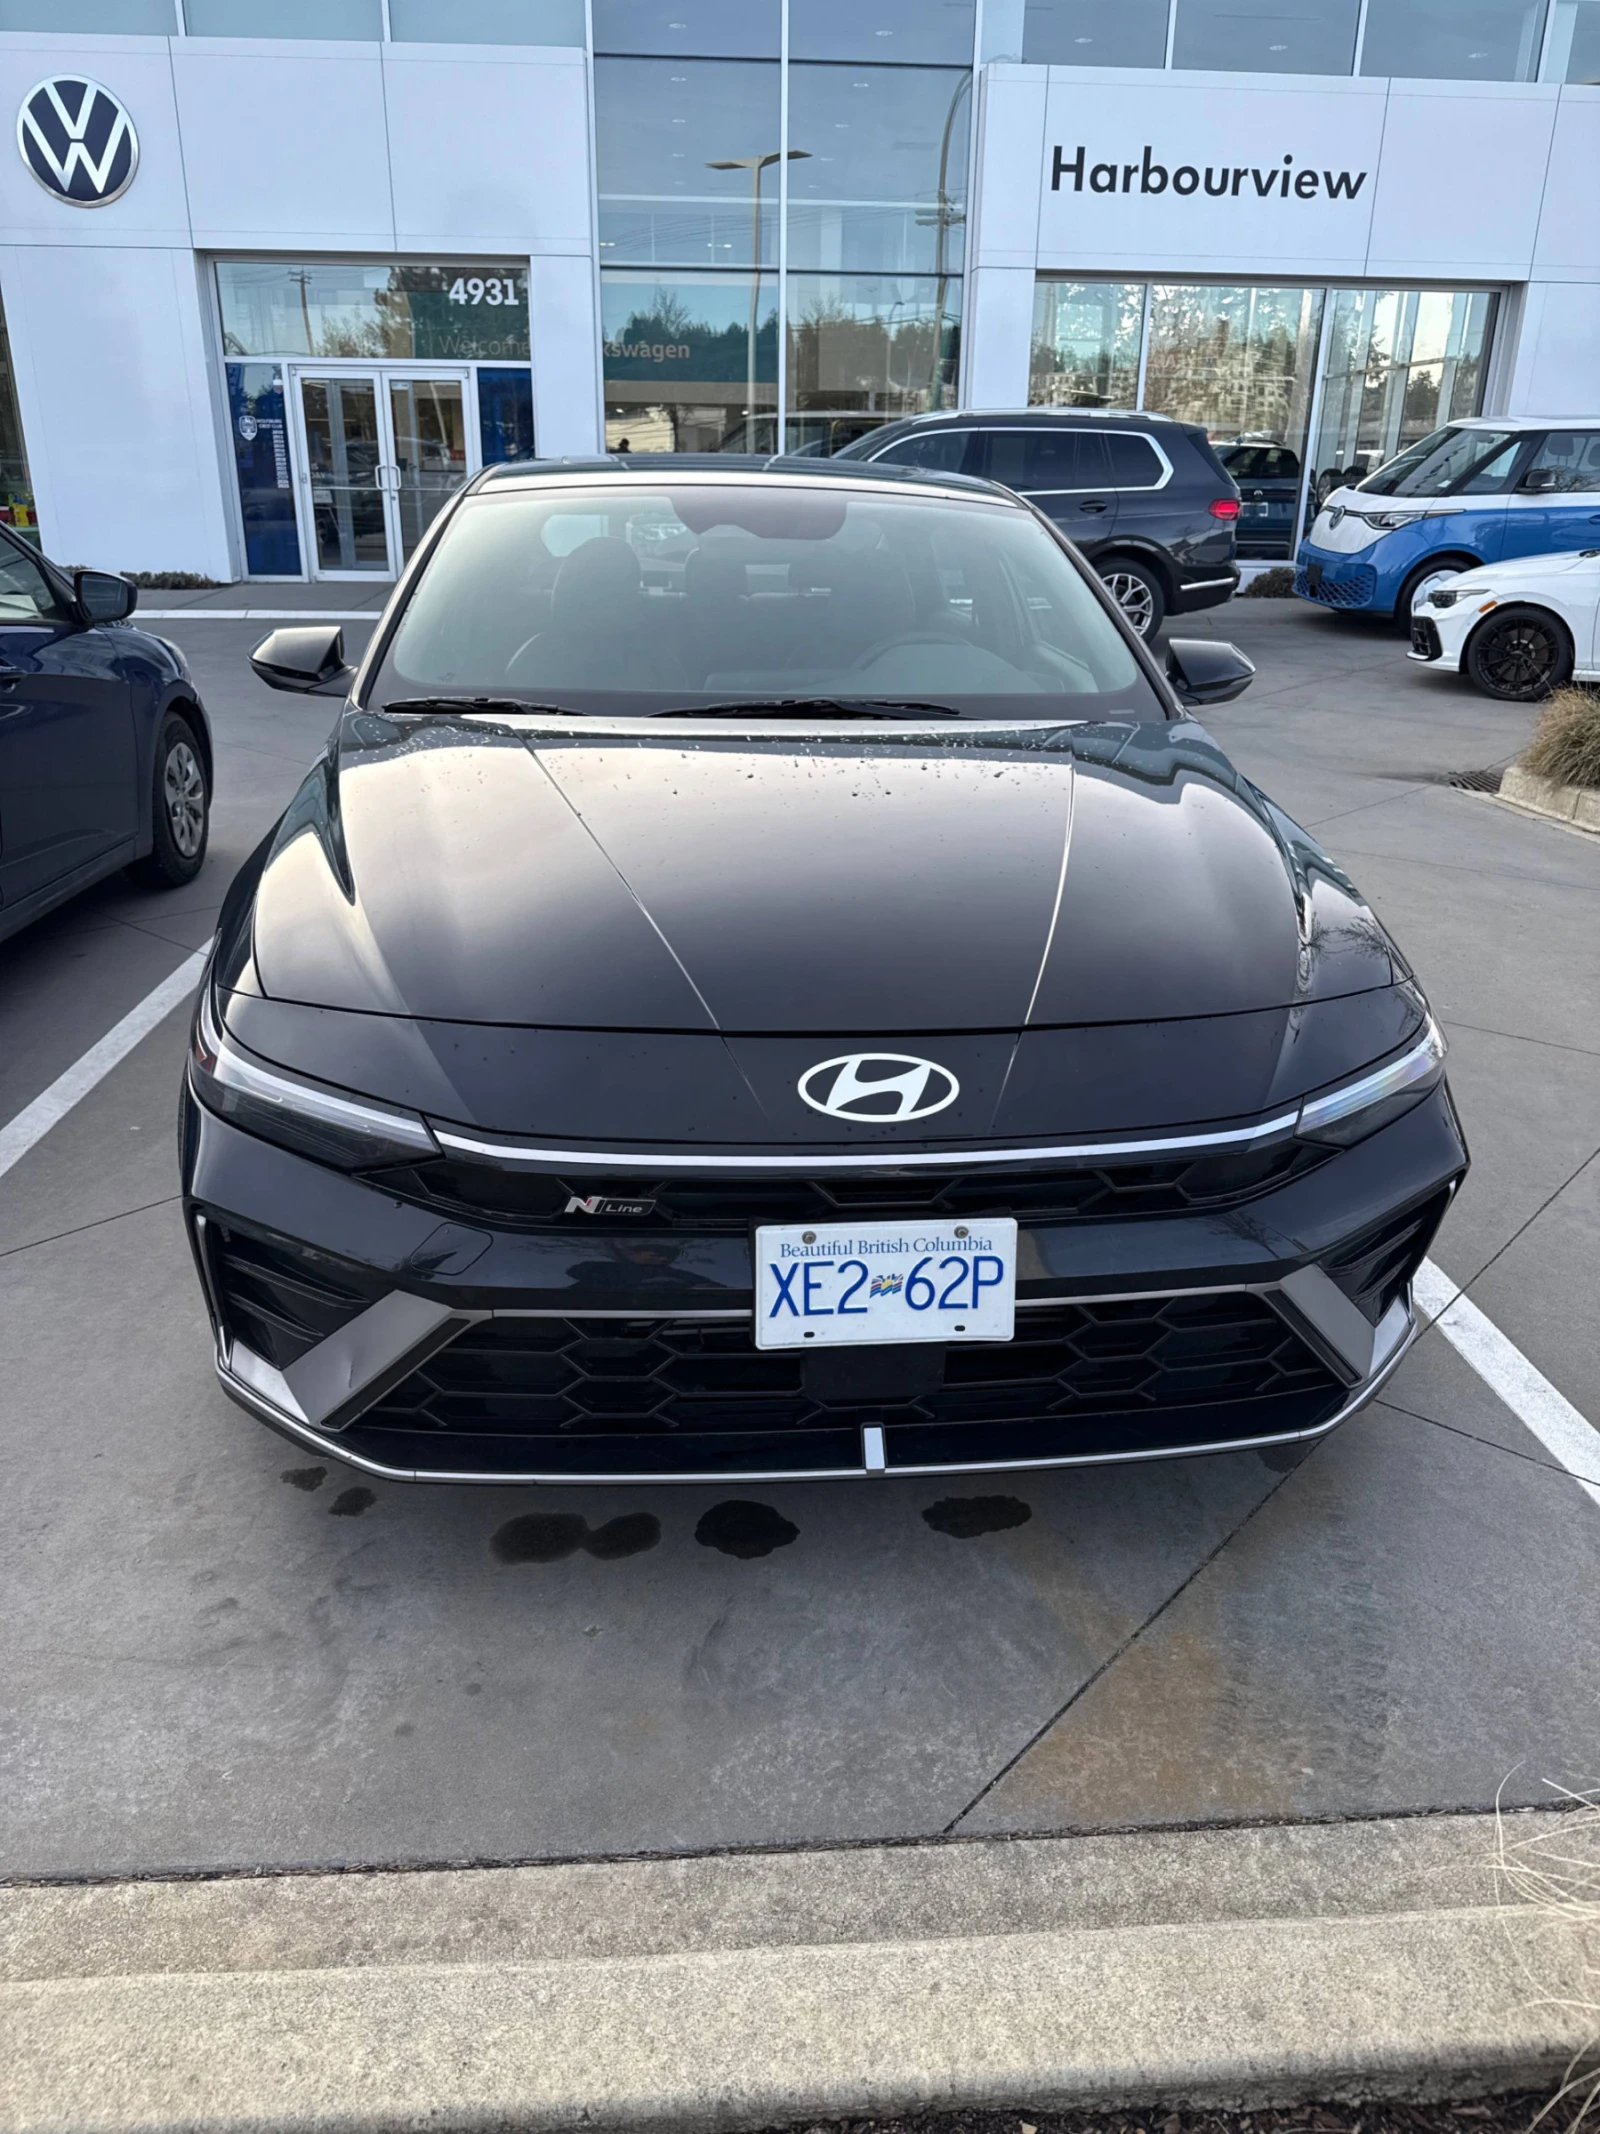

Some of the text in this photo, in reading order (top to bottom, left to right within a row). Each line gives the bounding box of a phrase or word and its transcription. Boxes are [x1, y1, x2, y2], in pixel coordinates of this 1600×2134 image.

[1051, 145, 1368, 199] Harbourview
[449, 278, 519, 306] 4931
[780, 1236, 992, 1258] Beautiful British Columbia
[769, 1255, 1004, 1318] XE2 62P
